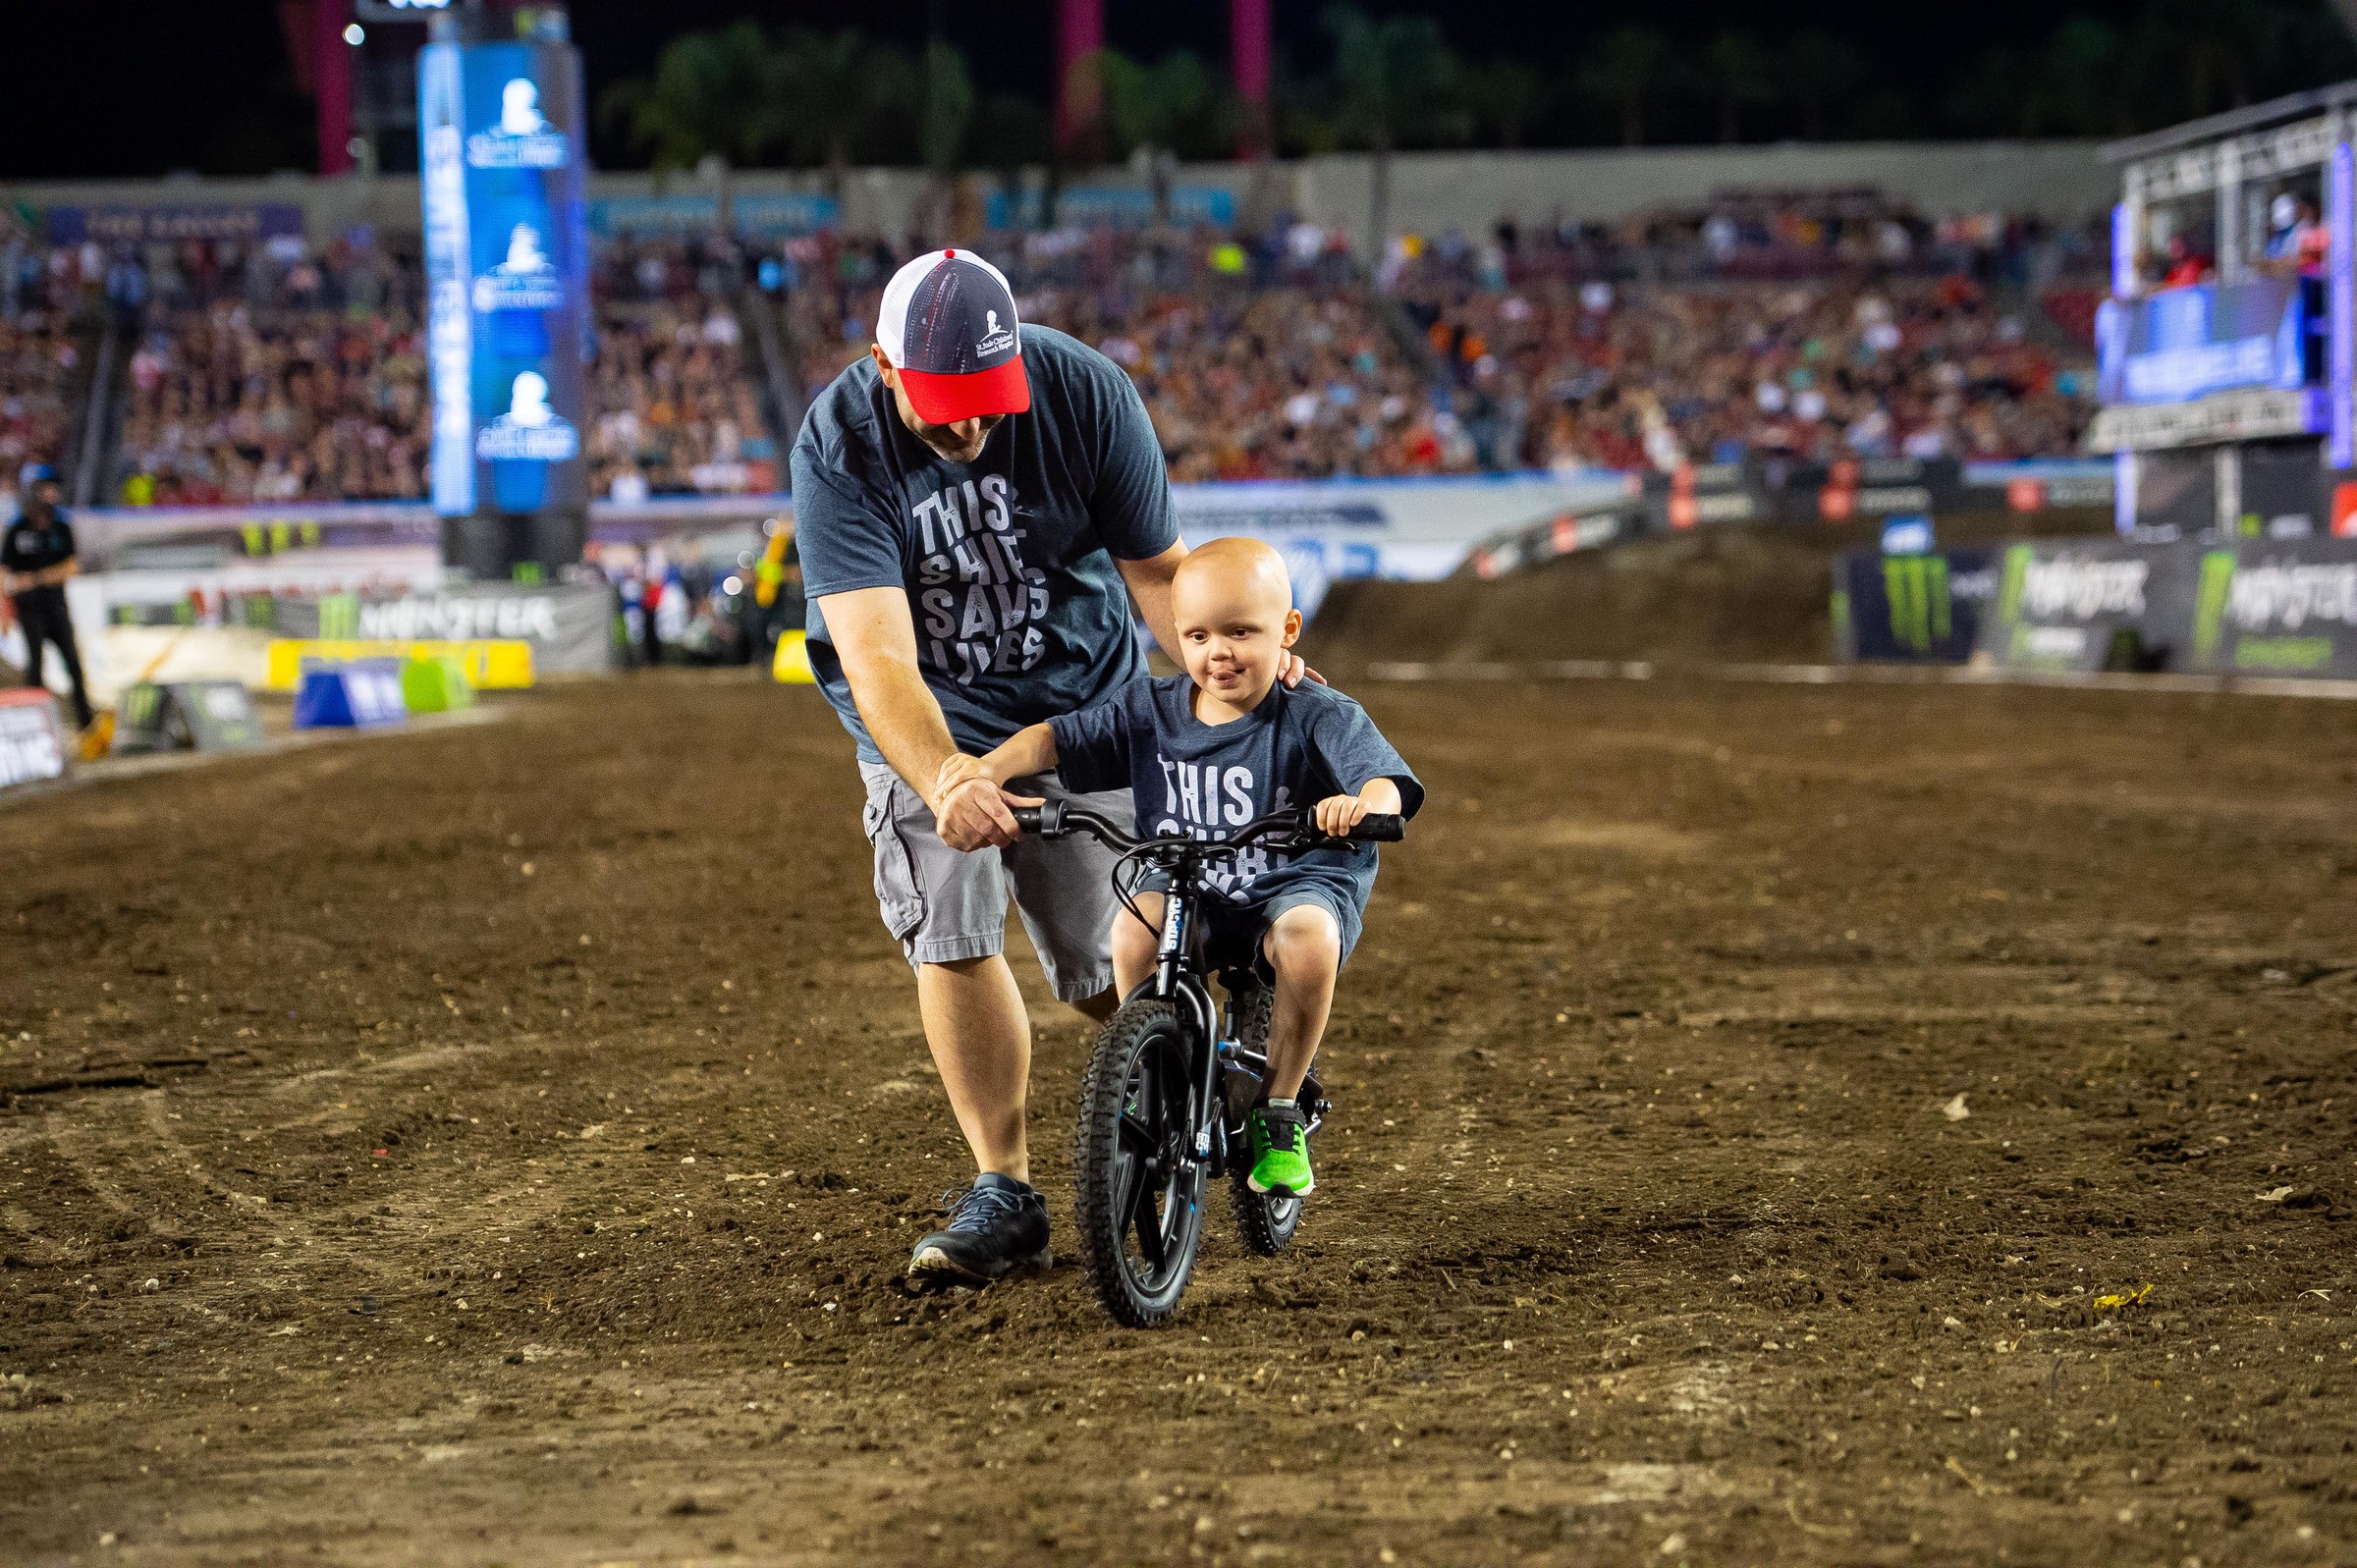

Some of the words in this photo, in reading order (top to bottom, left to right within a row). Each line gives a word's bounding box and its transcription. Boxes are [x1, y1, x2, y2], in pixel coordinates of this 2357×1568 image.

[912, 473, 1010, 555] THIS
[919, 529, 1026, 585] SHI
[359, 592, 559, 642] MONSTER
[921, 568, 1050, 639] SAVS
[1157, 753, 1254, 826] THIS
